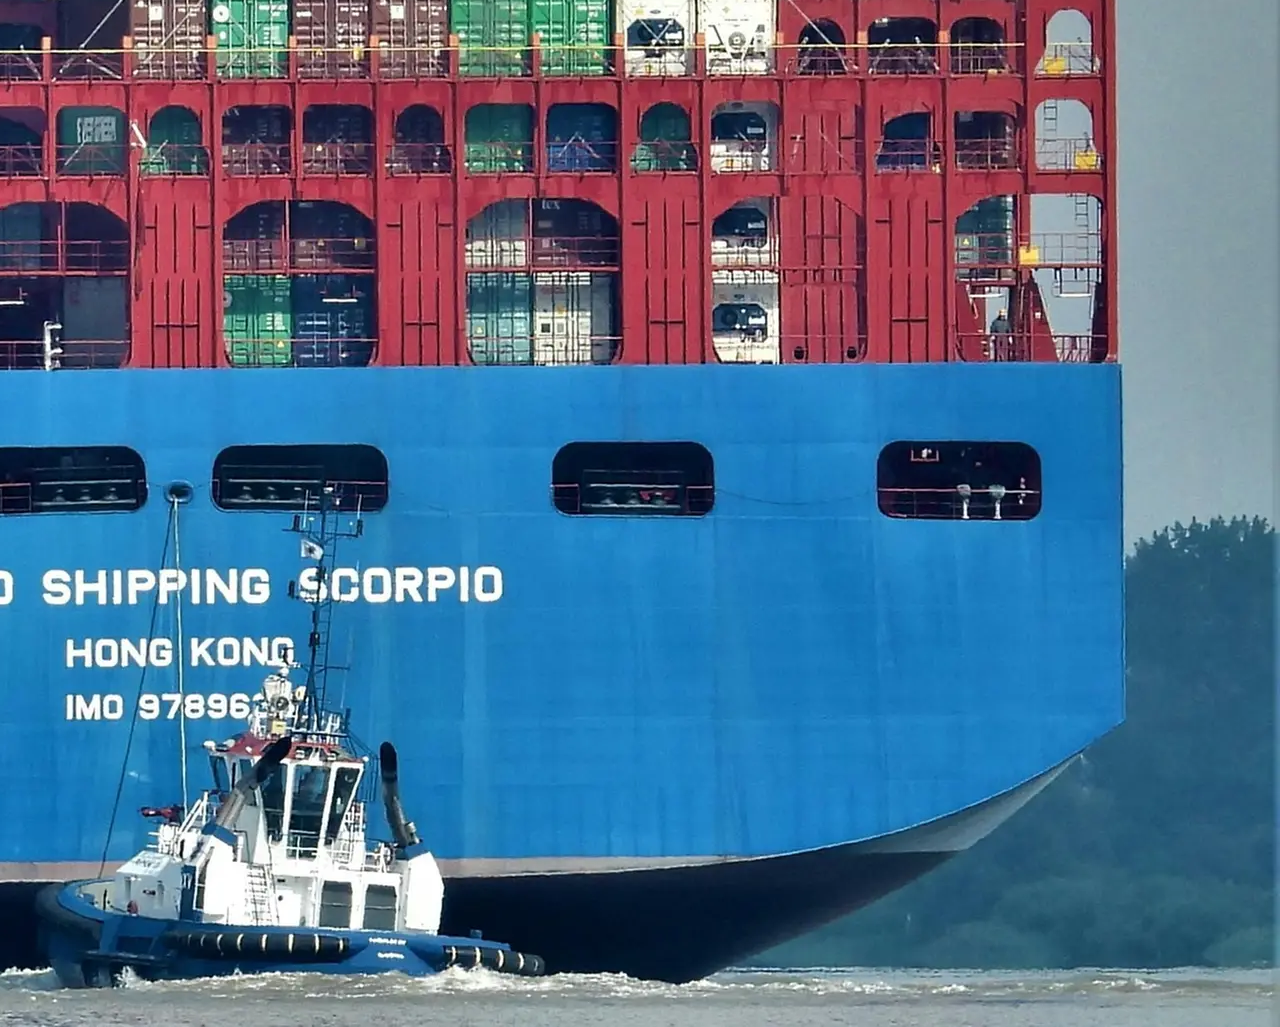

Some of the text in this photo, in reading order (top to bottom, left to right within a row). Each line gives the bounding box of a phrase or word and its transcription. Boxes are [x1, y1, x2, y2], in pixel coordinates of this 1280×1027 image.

[42, 568, 270, 606] SHIPPING
[298, 566, 503, 604] SCORPIO
[66, 636, 294, 668] HONG KONG
[66, 693, 124, 720] IMO
